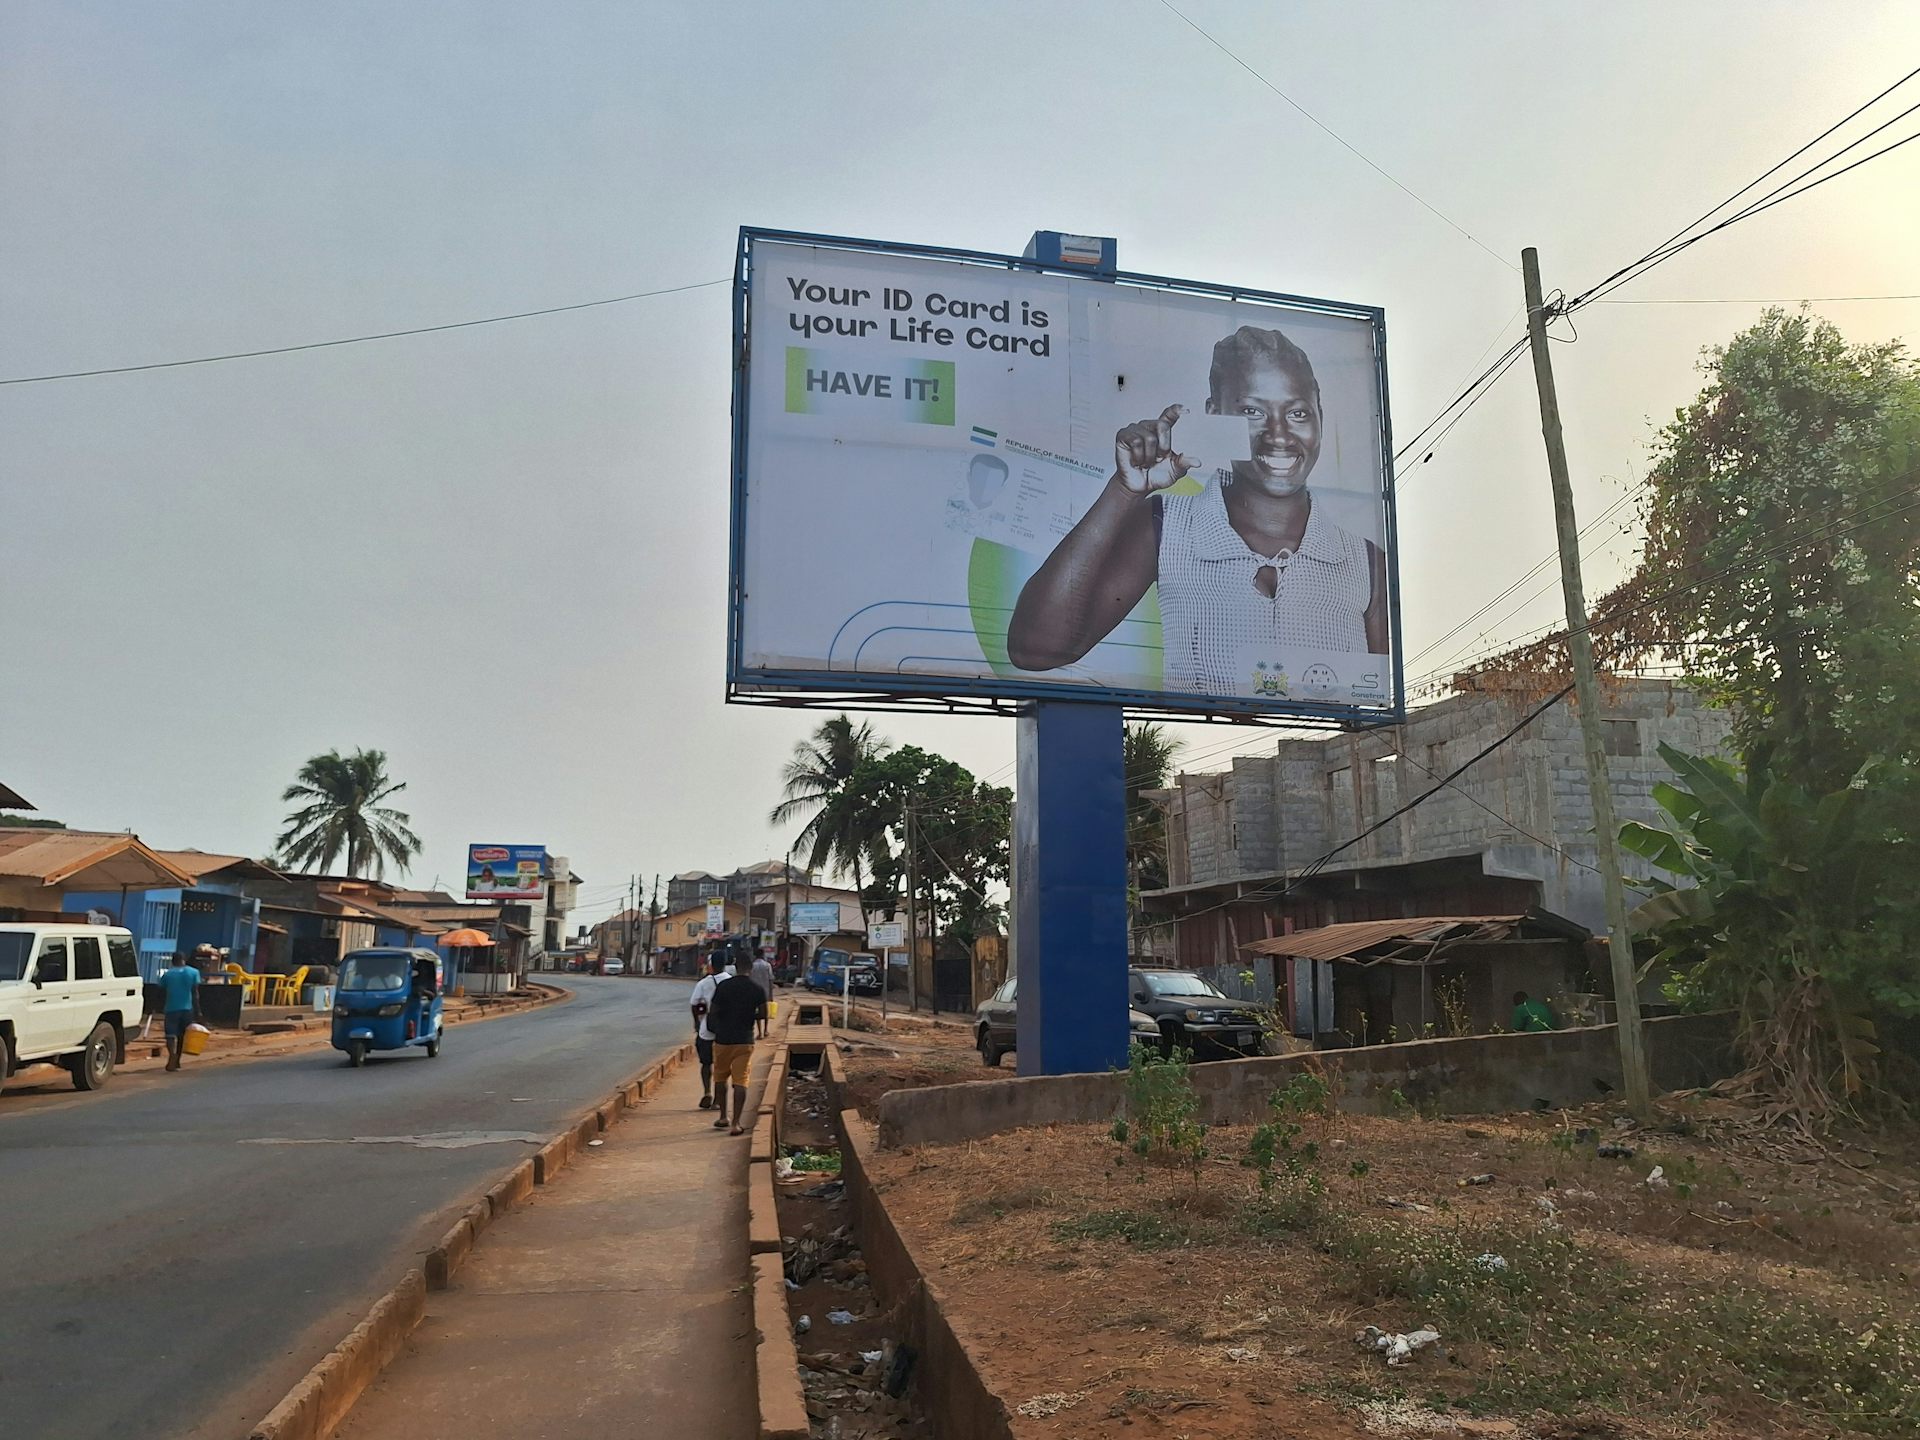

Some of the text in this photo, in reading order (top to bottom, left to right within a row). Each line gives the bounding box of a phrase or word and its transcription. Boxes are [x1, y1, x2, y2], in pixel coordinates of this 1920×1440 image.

[787, 277, 1049, 328] Your ID Card is
[789, 313, 1050, 357] your Life Card
[806, 369, 939, 402] HAVE IT!
[1005, 439, 1041, 454] REPUBLIC
[1054, 454, 1079, 466] SIERRA
[1080, 462, 1105, 474] LEONE
